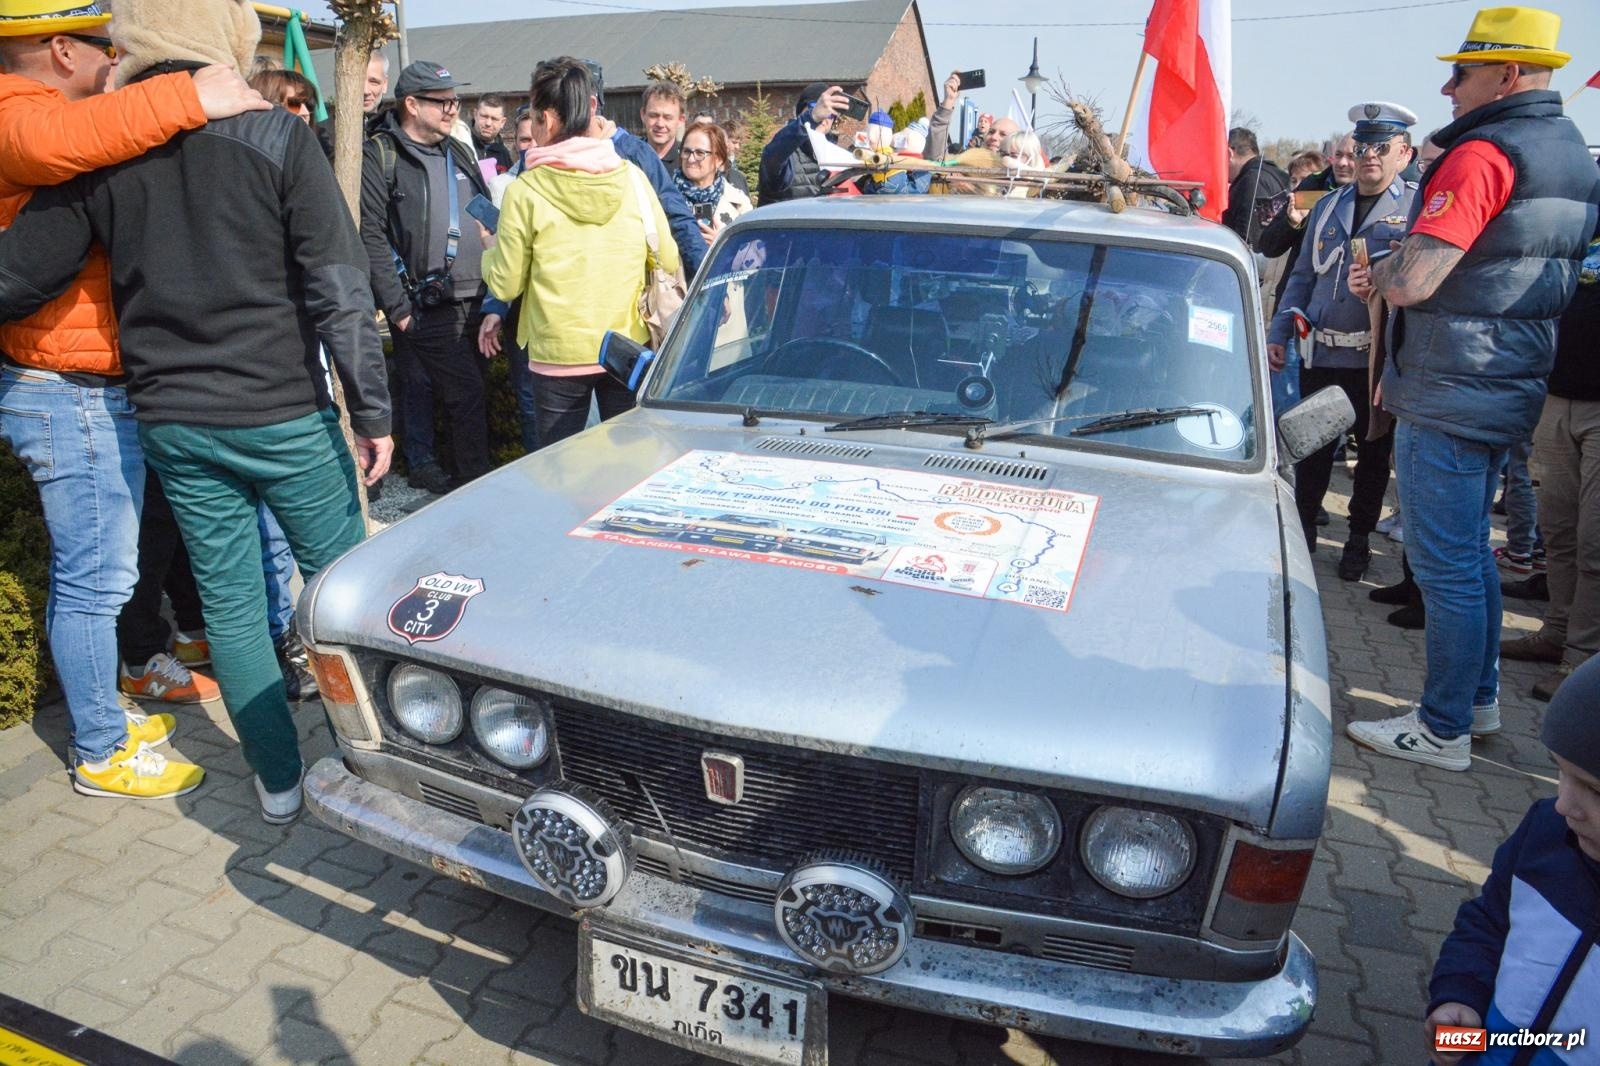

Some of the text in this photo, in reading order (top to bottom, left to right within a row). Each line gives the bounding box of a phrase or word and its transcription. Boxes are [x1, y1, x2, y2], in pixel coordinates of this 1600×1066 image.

[809, 500, 831, 509] DO
[602, 533, 683, 552] TAJLANDIA
[697, 546, 752, 560] OŁAWA
[424, 577, 476, 593] OLD VW
[427, 590, 453, 601] CLUB
[416, 599, 440, 622] 3
[404, 619, 433, 636] CITY
[610, 953, 798, 1036] ขน 7341
